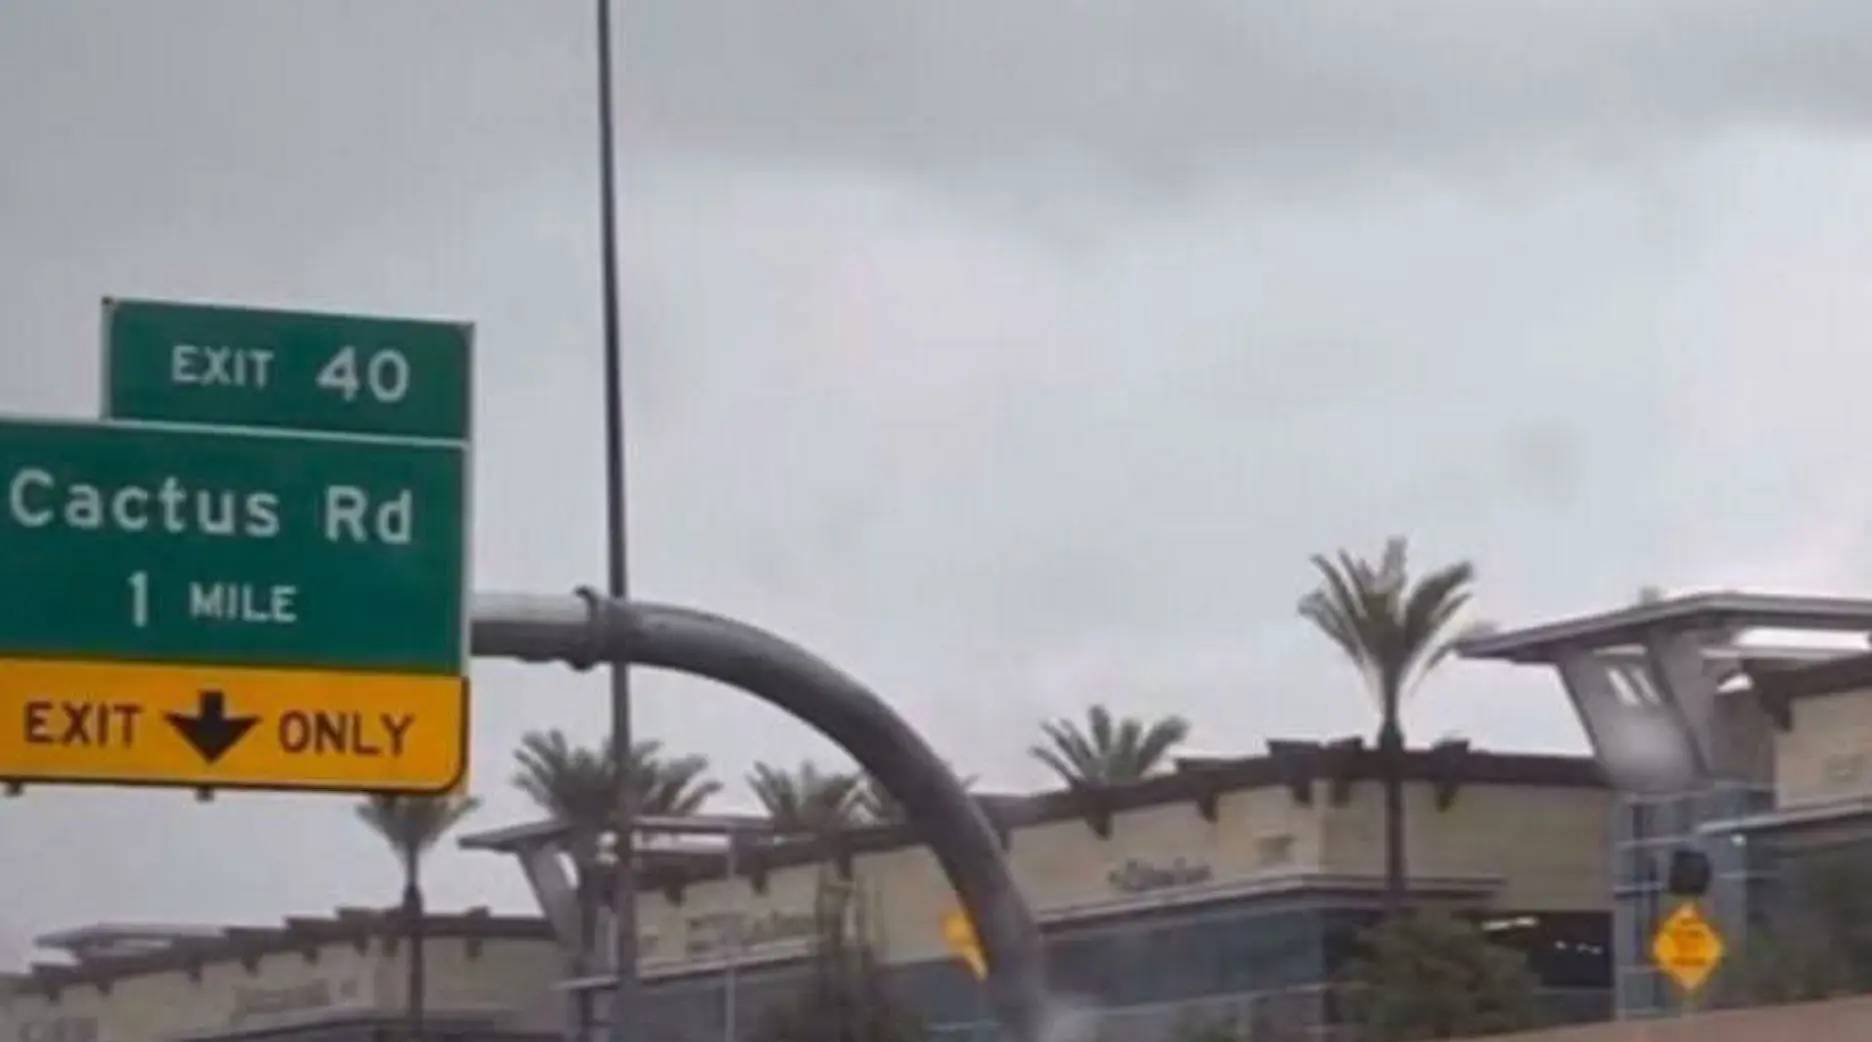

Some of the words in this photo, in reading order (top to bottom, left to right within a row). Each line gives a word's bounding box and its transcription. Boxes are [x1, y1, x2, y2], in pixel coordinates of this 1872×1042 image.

[172, 345, 274, 387] EXIT
[317, 346, 409, 401] 40
[9, 469, 280, 537] Cactus
[324, 485, 413, 544] Rd
[128, 571, 148, 627] 1
[190, 582, 297, 622] MILE
[24, 701, 143, 746] EXIT
[279, 710, 415, 756] ONLY
